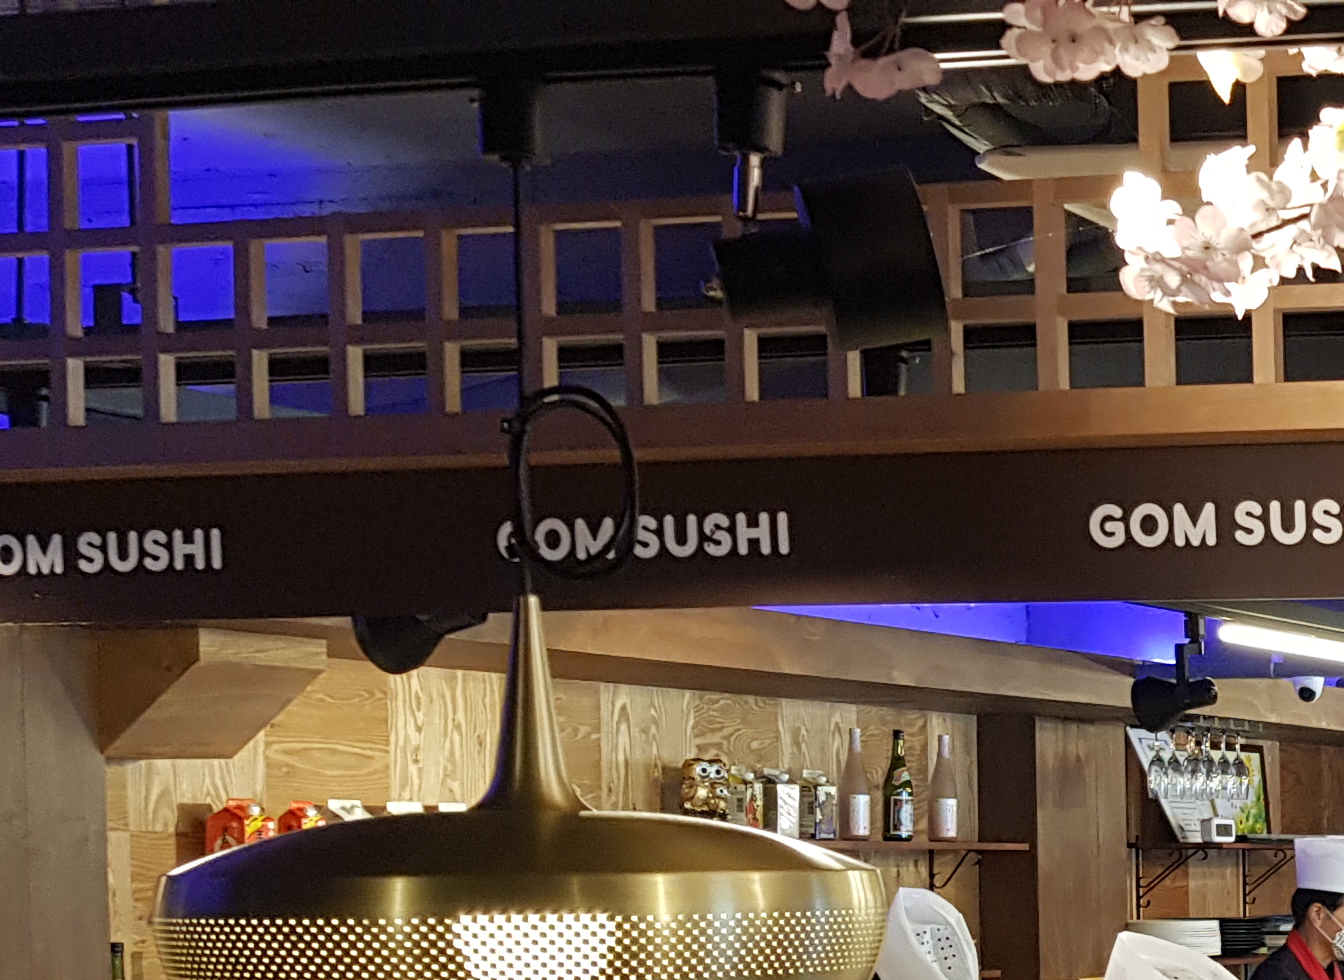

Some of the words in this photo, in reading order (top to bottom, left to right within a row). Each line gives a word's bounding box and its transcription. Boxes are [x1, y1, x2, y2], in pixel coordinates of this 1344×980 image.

[632, 511, 790, 559] SUSHI
[1089, 502, 1217, 548] GOM
[77, 527, 222, 574] SUSHI
